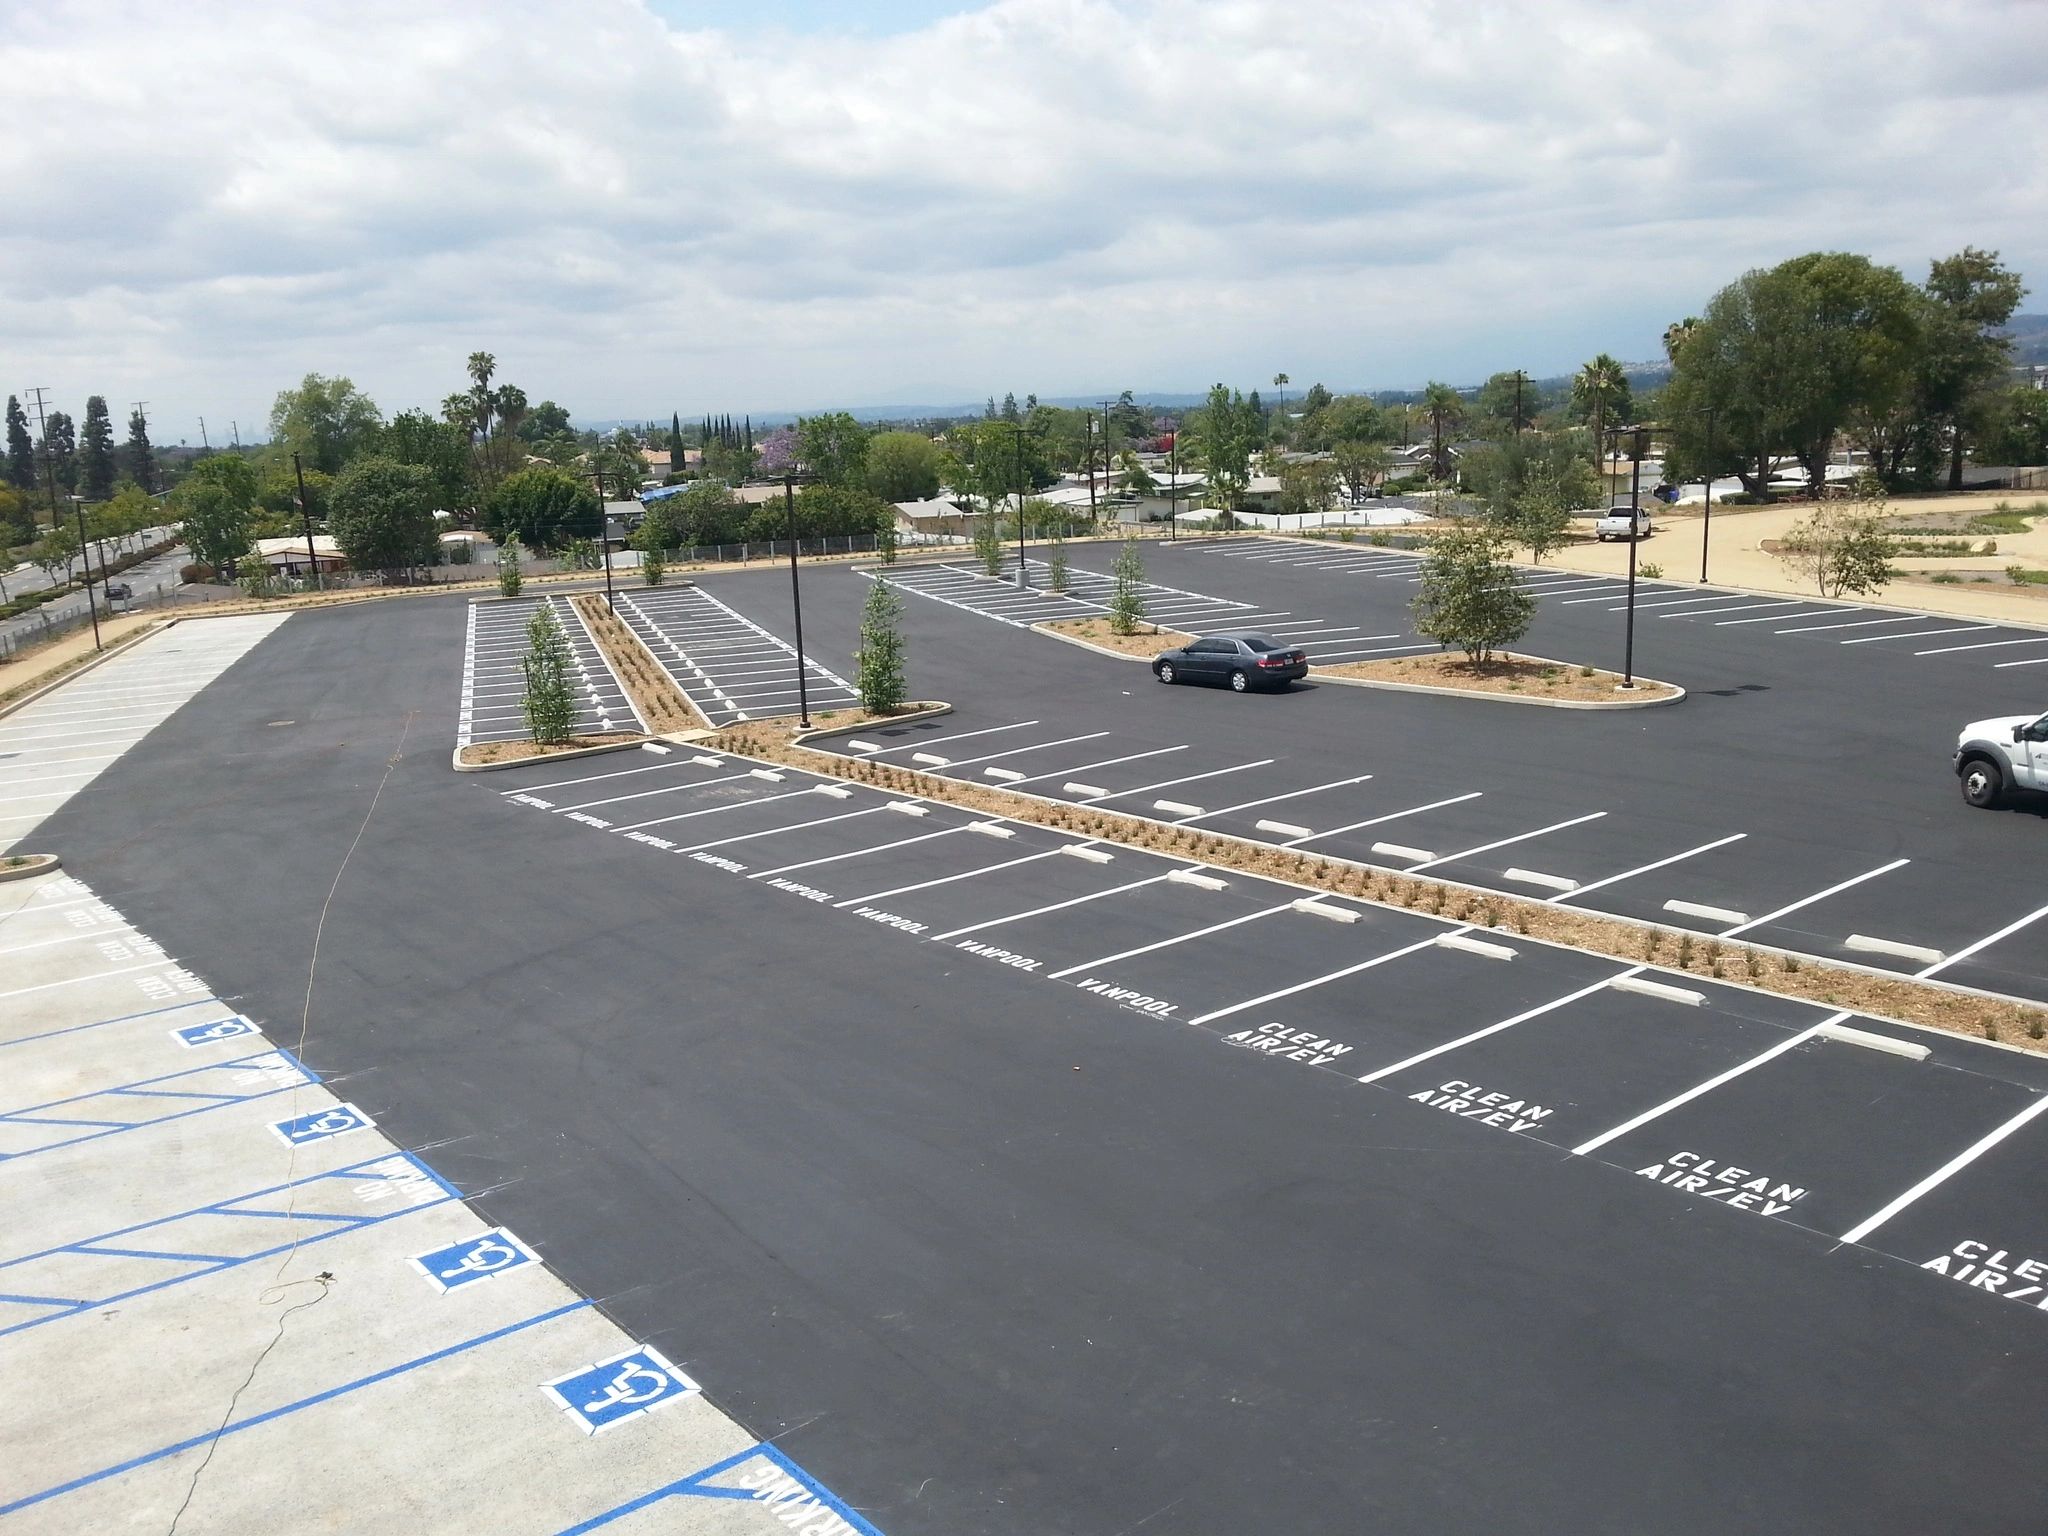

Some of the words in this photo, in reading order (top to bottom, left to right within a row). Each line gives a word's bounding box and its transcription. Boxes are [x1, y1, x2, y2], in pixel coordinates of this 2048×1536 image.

[623, 831, 678, 850] VANPOOL
[688, 851, 748, 874] VANPOOL
[766, 877, 834, 903] VANPOOL
[852, 906, 930, 935] VANPOOL
[954, 939, 1045, 972] VANPOOL
[1075, 977, 1179, 1017] VANPOOL
[1226, 1029, 1335, 1066] AIR/EV
[1257, 1021, 1354, 1056] CLEAN
[1407, 1089, 1538, 1133] AIR/EV
[1438, 1079, 1554, 1121] CLEAN
[353, 1180, 398, 1202] NO
[373, 1157, 452, 1206] PARKING
[1634, 1163, 1793, 1217] AIR/EV
[1667, 1150, 1806, 1202] CLEAN
[1952, 1239, 2048, 1283] CLE
